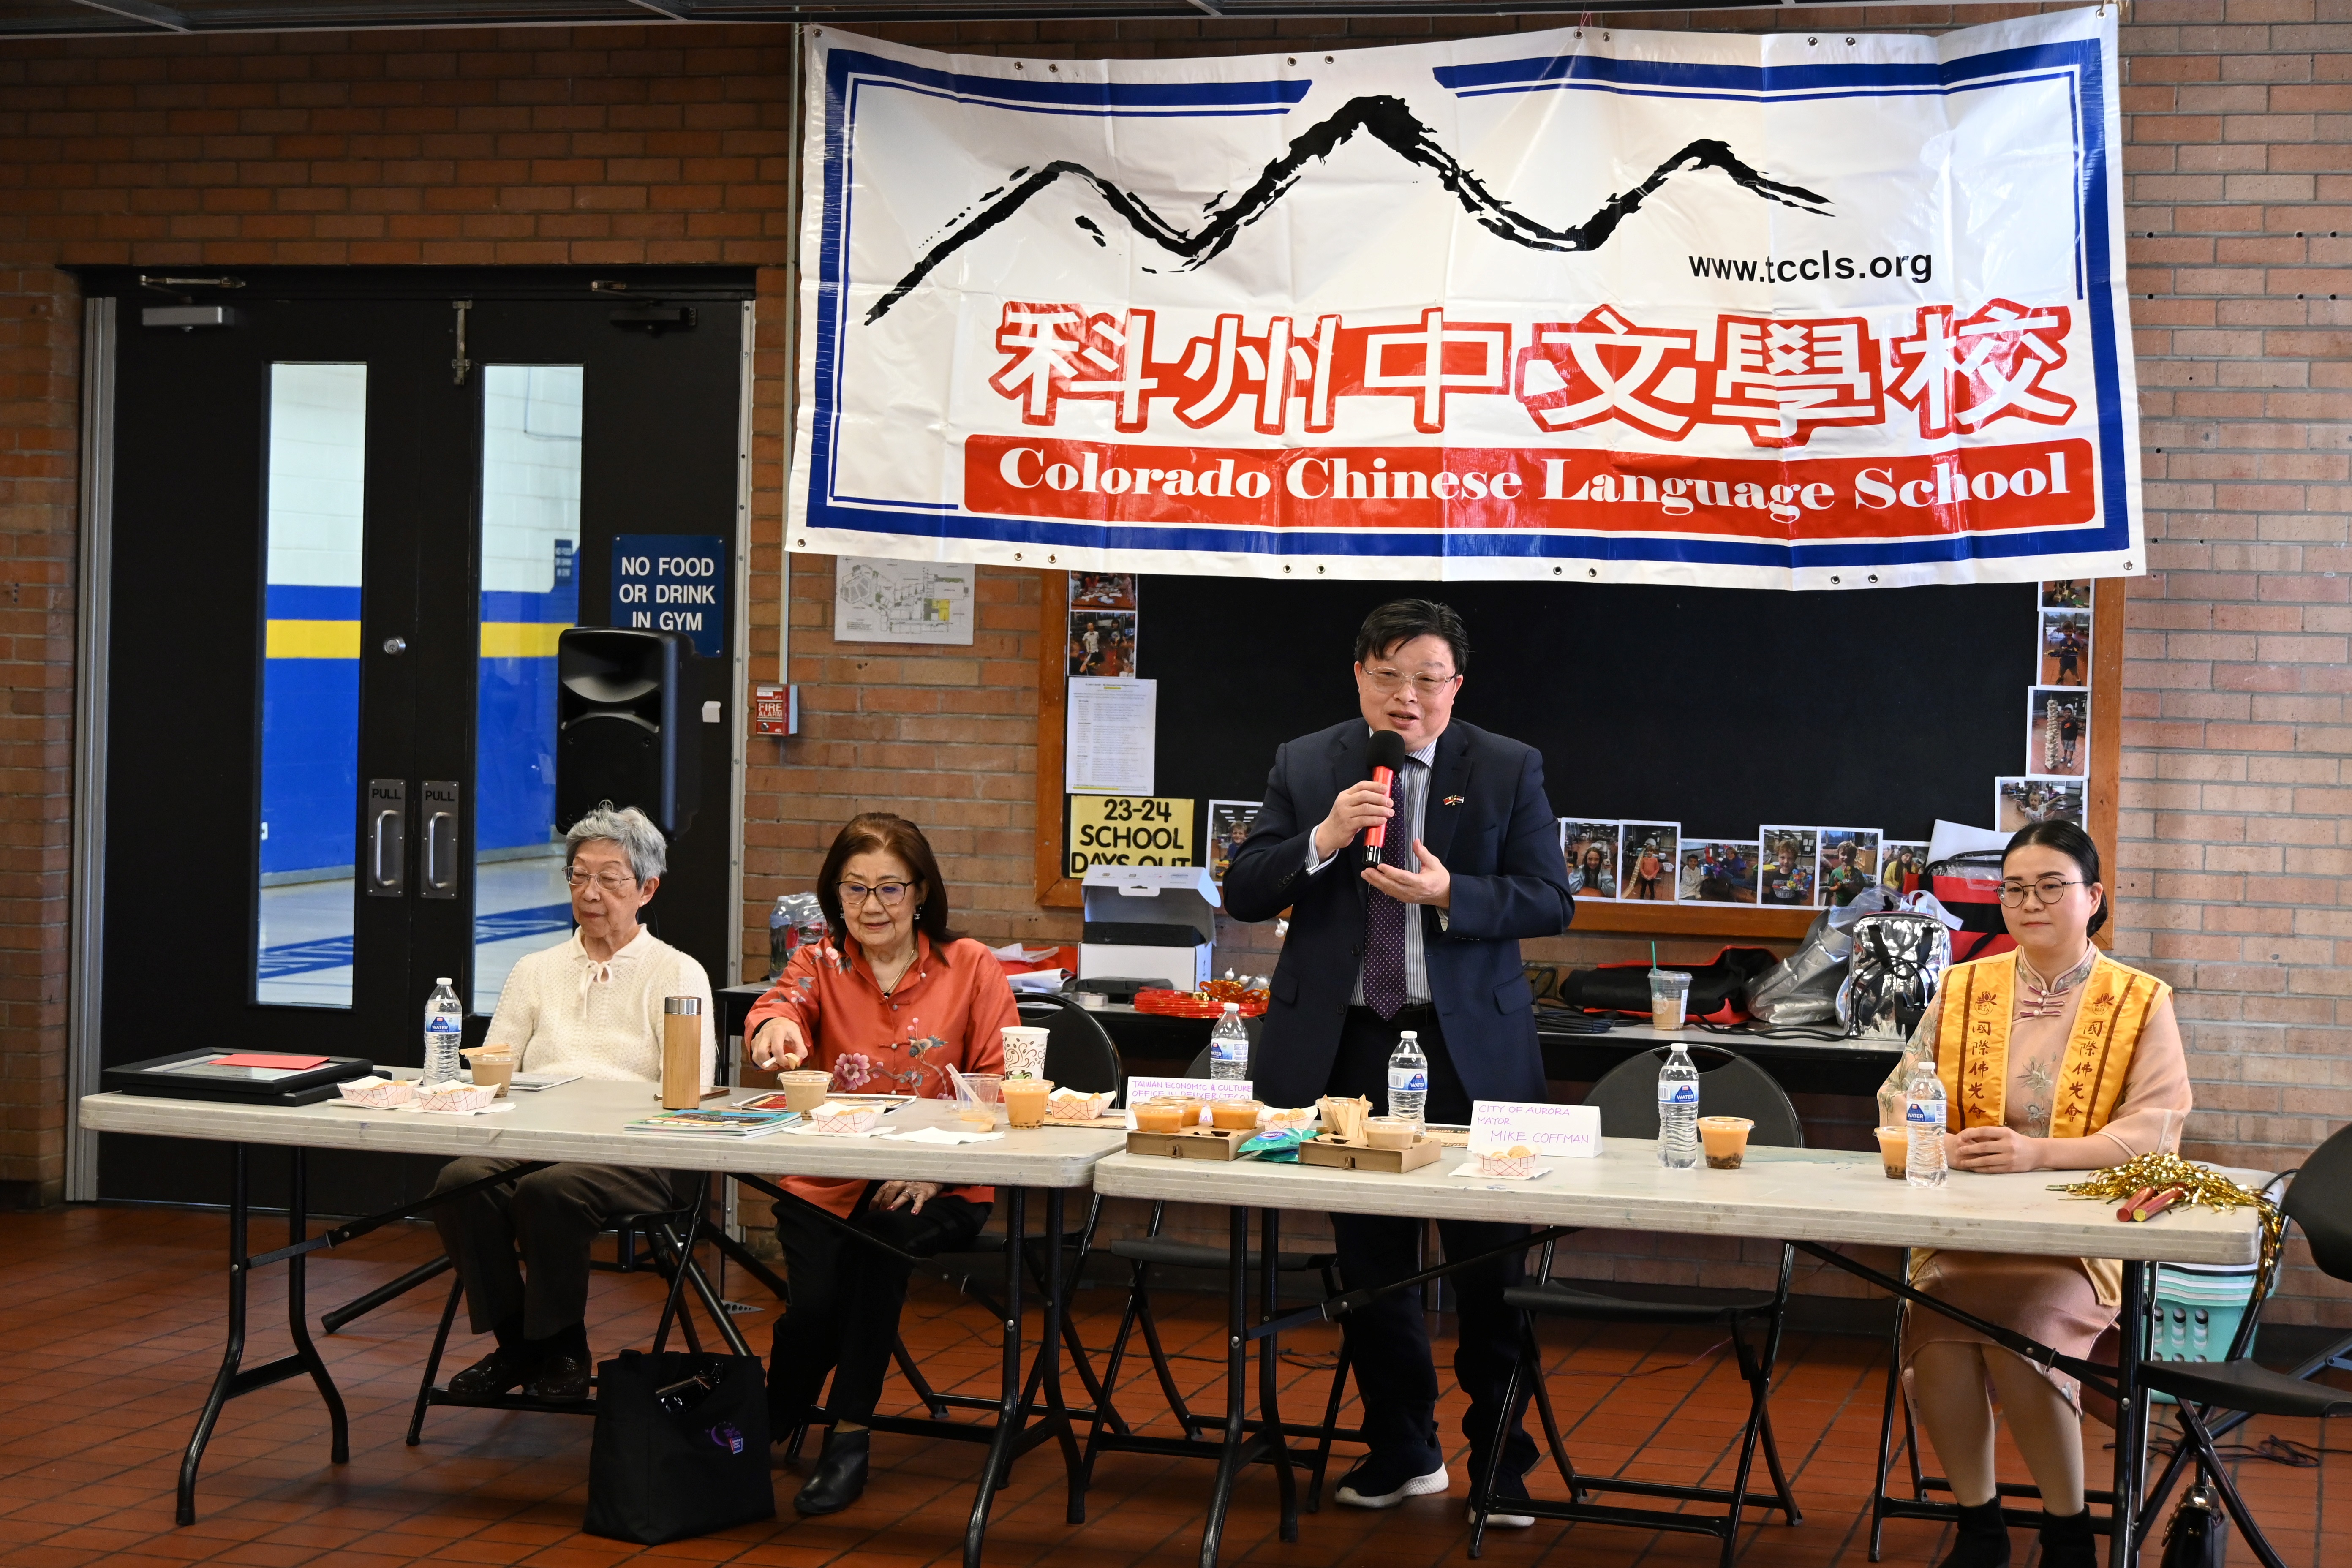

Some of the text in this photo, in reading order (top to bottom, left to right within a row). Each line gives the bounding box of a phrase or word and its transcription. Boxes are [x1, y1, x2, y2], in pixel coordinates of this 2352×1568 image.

[1689, 250, 1932, 283] www.tccls.org
[991, 299, 2076, 446] 科州中文學校
[999, 447, 2071, 523] Colorado Chinese Language School
[622, 557, 714, 577] NO FOOD
[619, 584, 716, 604] OR DRINK
[632, 611, 702, 631] IN GYM
[758, 703, 782, 711] FIRE
[372, 789, 401, 799] PULL
[425, 791, 455, 801] PULL
[1104, 799, 1172, 823] 23-24
[1079, 824, 1184, 849] SCHOOL
[1071, 852, 1130, 873] DAYS
[1165, 1082, 1207, 1091] ECONOMIC
[1479, 1105, 1505, 1113] CITY
[1526, 1107, 1570, 1116] AURORA
[1478, 1117, 1511, 1125] MAYOR
[1491, 1130, 1588, 1143] MIKE COFFMAN
